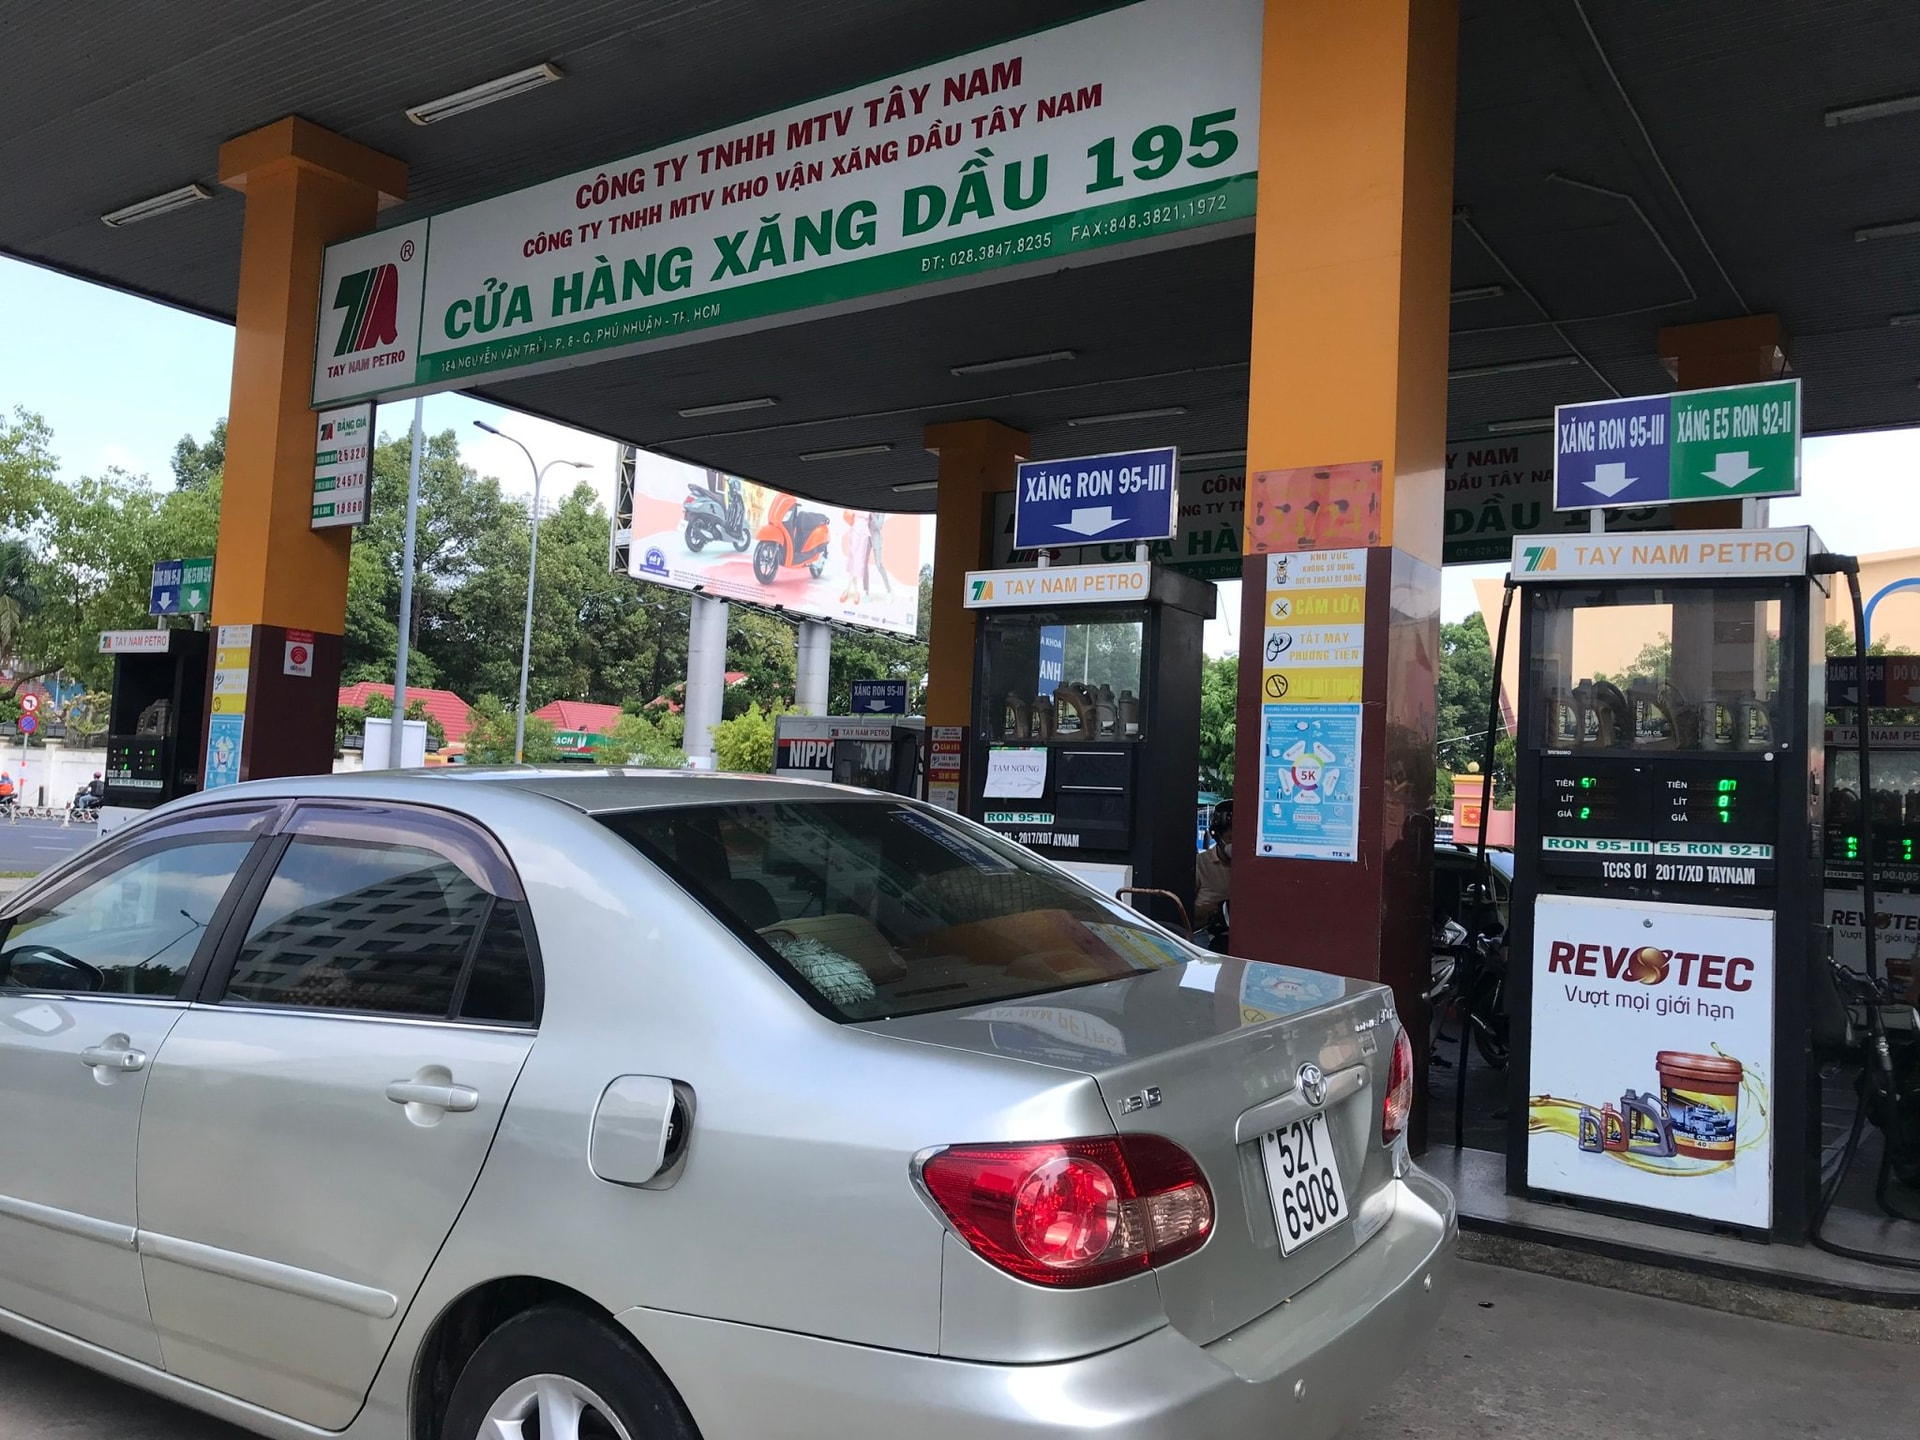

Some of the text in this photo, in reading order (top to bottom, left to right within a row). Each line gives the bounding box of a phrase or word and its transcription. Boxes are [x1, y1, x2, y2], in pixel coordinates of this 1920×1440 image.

[576, 57, 1022, 209] CÔNG TY TNHH MTV TÂY NAM
[523, 83, 1102, 258] CÔNG TY TNHH MTV KHO VẬN XĂNG DẦU TÂY NAM
[444, 108, 1238, 339] CỬA HÀNG XĂNG DẦU 195
[950, 232, 1052, 267] 028.3847.8235
[597, 322, 618, 342] PHÚ
[694, 303, 720, 320] HCM
[328, 350, 405, 378] TAY NAM PETRO
[1677, 400, 1792, 443] XĂNG E5 RON 92-II
[1560, 414, 1665, 454] XĂNG RON 95-III
[1467, 447, 1518, 467] NAM
[1025, 464, 1167, 503] XĂNG RON 95-III
[1202, 474, 1247, 494] CÔN
[1531, 469, 1554, 483] NA
[1205, 502, 1224, 514] TY
[1188, 522, 1238, 556] HÀ
[1575, 541, 1795, 565] TAY NAM PETRO
[1005, 572, 1143, 596] TAY NAM PETRO
[115, 635, 167, 646] TAY NAM PETRO
[854, 684, 904, 696] XĂNG RON 95-III
[870, 728, 890, 736] PETRO
[1842, 731, 1858, 740] TA
[1871, 731, 1899, 740] NAM
[789, 741, 835, 768] NIPPO
[1301, 770, 1316, 780] 5K
[1561, 794, 1574, 803] LÍT
[1673, 796, 1687, 806] LÍT
[987, 813, 1052, 822] RON 95-III
[1557, 808, 1573, 818] GIÁ
[1671, 811, 1688, 822] GIÁ
[1548, 839, 1649, 852] RON 95-III
[1659, 843, 1770, 857] E5 RON 92-II
[1602, 862, 1756, 885] TCCS 01 2017/XD TAYNAM
[1565, 985, 1734, 1021] Vượt mọi giới hạn
[1276, 1115, 1320, 1178] 52Y
[1283, 1167, 1339, 1240] 6908
